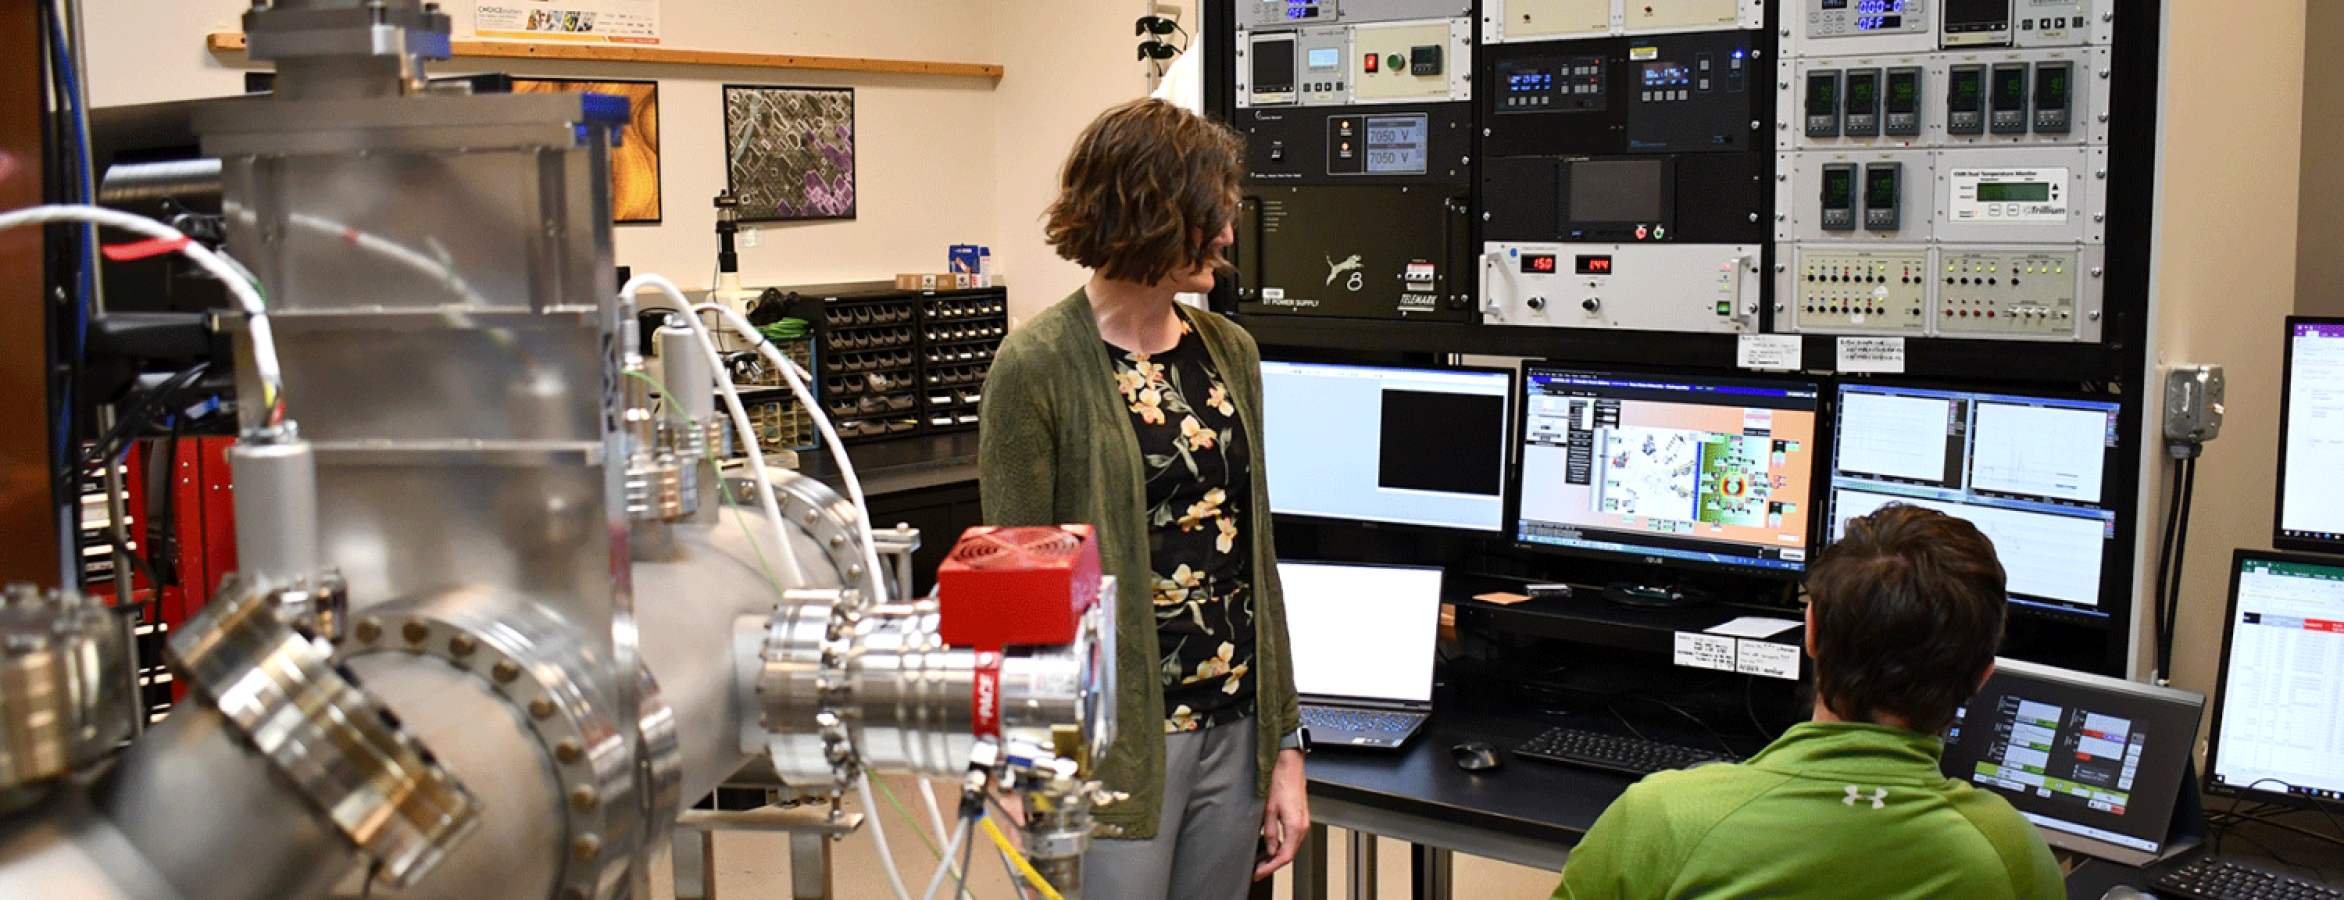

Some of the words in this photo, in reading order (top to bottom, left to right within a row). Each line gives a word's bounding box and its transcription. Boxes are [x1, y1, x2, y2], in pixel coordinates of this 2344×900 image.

[1288, 7, 1306, 20] OFF
[1858, 16, 1884, 31] OFF
[1370, 130, 1396, 142] 7050
[1401, 130, 1409, 142] V
[1370, 152, 1396, 164] 7050
[1401, 152, 1409, 164] V
[2031, 205, 2065, 215] Trillium
[1347, 272, 1363, 291] 8
[1271, 299, 1295, 307] POWER
[1296, 299, 1320, 307] SUPPLY
[1401, 294, 1437, 305] TELEMARK
